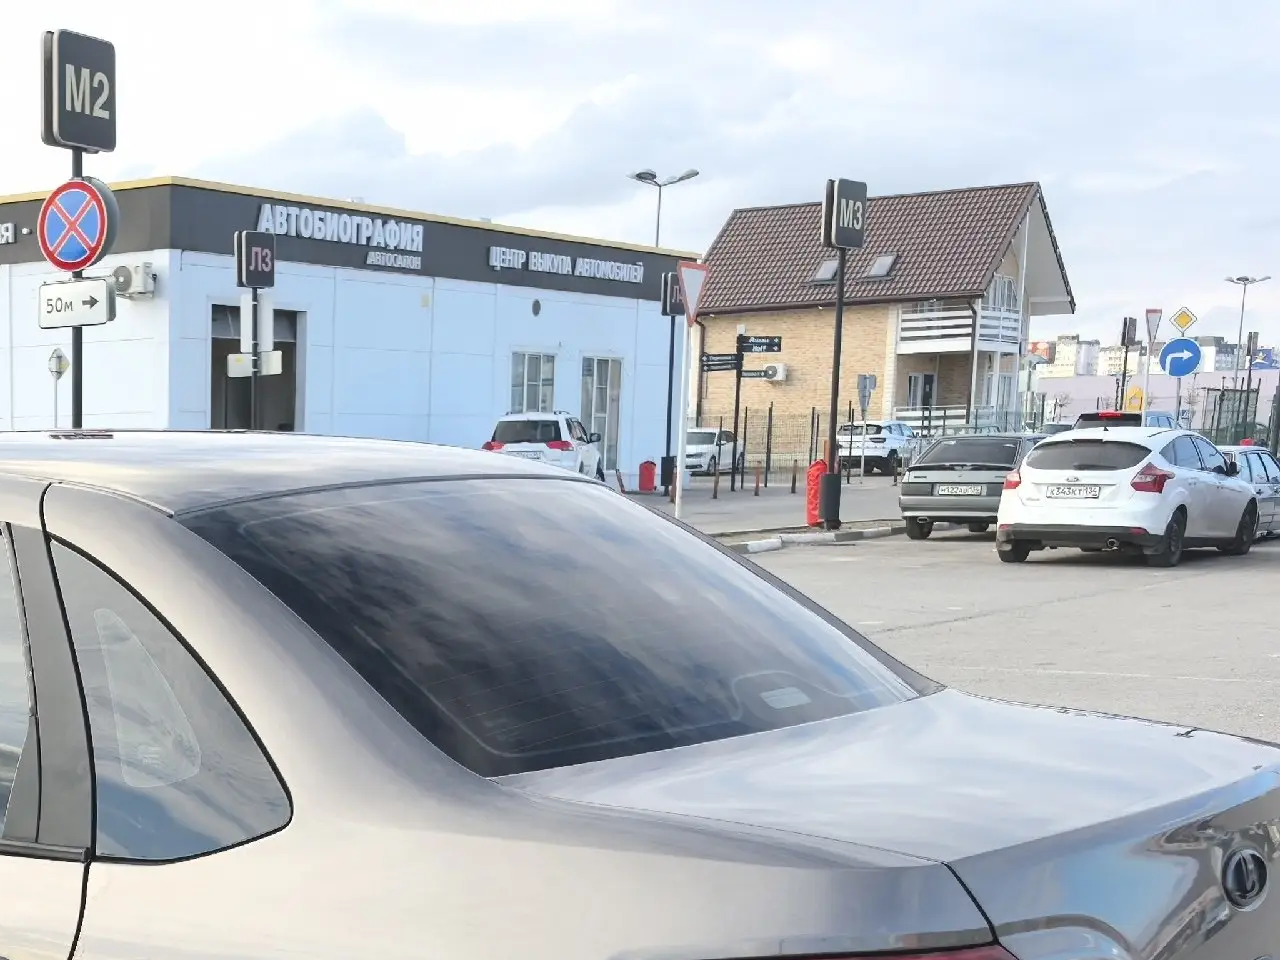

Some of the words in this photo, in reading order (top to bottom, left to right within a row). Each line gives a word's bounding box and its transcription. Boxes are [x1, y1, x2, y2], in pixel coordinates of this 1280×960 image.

[65, 63, 110, 120] М2
[257, 203, 424, 252] АВТОБИОГРАФИЯ
[840, 198, 863, 230] М3
[249, 246, 273, 272] Л3
[366, 251, 422, 270] АВТОСАЛОН
[489, 246, 526, 270] ЦЕНТР
[528, 251, 572, 275] ВЫКУПА
[574, 257, 644, 283] АВТОМОБИЛЕЙ
